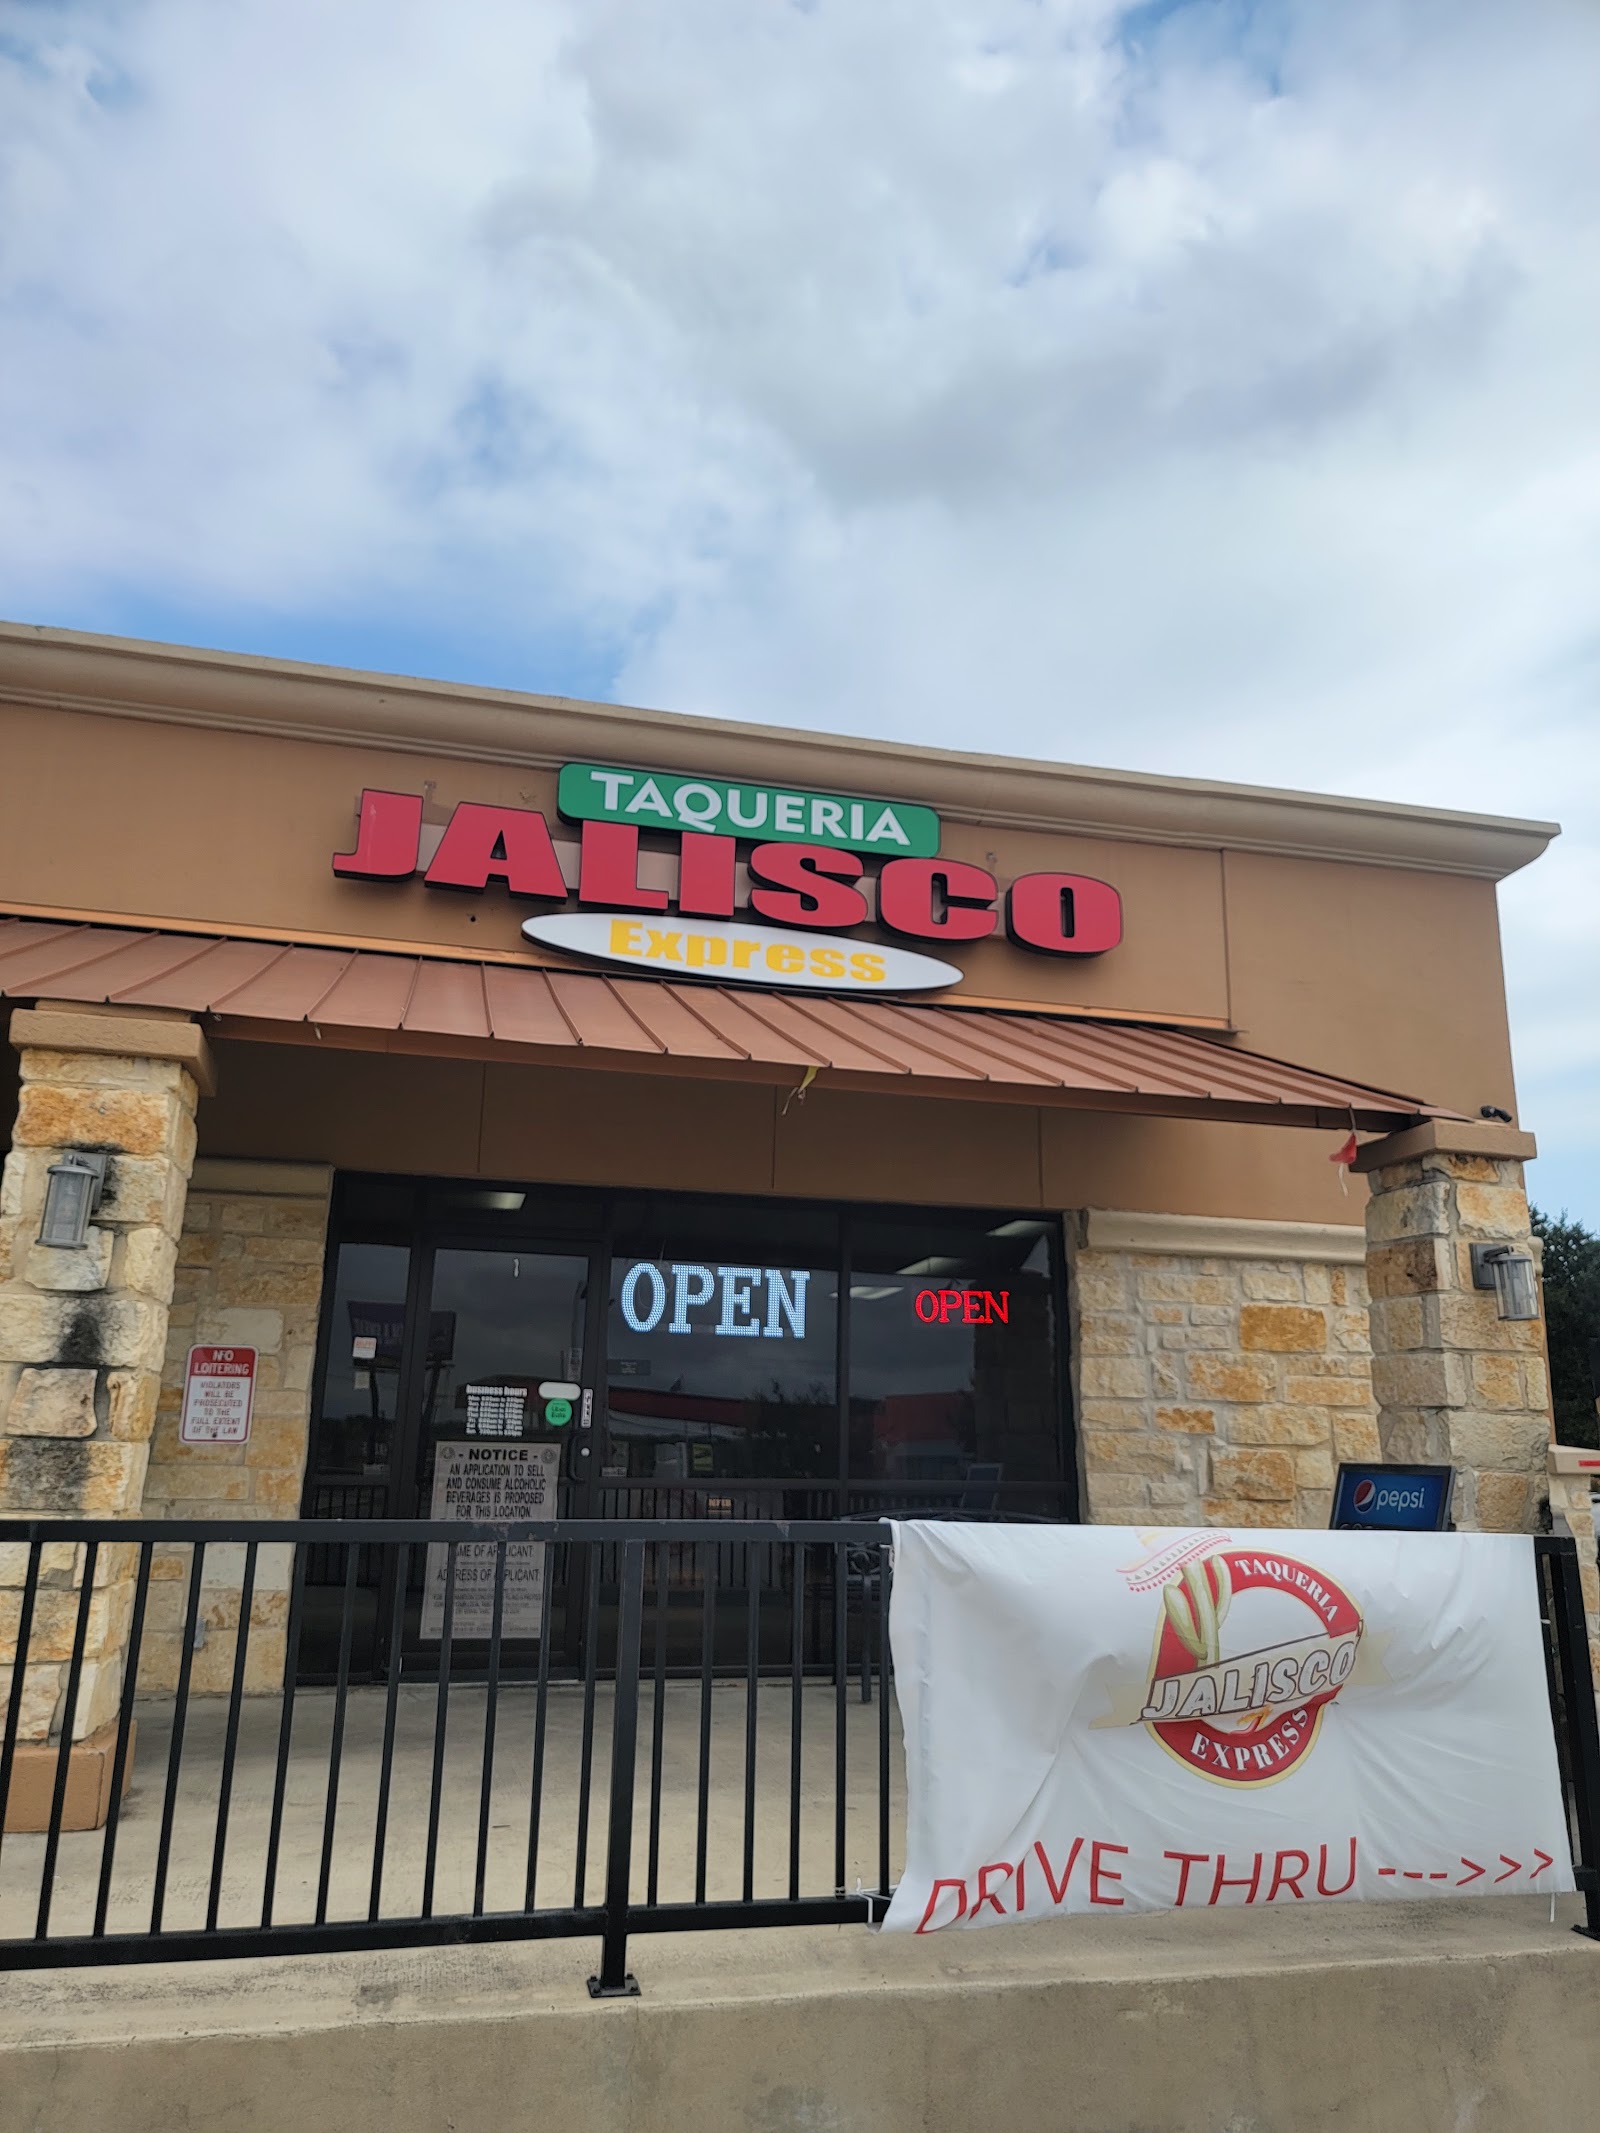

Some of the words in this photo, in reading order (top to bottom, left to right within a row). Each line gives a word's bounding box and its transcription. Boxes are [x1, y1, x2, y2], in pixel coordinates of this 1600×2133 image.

[590, 770, 911, 847] TAQUERIA
[332, 788, 1124, 957] JALISCO
[609, 919, 887, 984] Express
[620, 1262, 811, 1339] OPEN
[914, 1288, 1011, 1325] OPEN
[212, 1349, 234, 1361] NO
[193, 1363, 250, 1375] LOITERING
[200, 1381, 241, 1389] VIOLATORS
[466, 1384, 503, 1396] business
[504, 1386, 528, 1397] hours
[204, 1390, 222, 1398] WILL
[193, 1399, 243, 1407] PROSECUTED
[213, 1417, 241, 1425] EXTENT
[468, 1448, 529, 1461] NOTICE
[450, 1463, 460, 1475] AN
[463, 1464, 511, 1476] APPLICATION
[514, 1464, 524, 1476] TO
[527, 1464, 545, 1477] SELL
[446, 1477, 462, 1489] AND
[465, 1477, 501, 1490] CONSUME
[504, 1478, 546, 1491] ALCOHOLIC
[446, 1490, 491, 1503] BEVERAGES
[494, 1491, 501, 1503] IS
[504, 1491, 545, 1504] PROPOSED
[1376, 1487, 1425, 1512] pepsi
[456, 1505, 472, 1517] FOR
[475, 1505, 491, 1517] THIS
[474, 1545, 486, 1557] OF
[437, 1568, 478, 1581] ADRESS
[480, 1569, 492, 1581] OF
[1235, 1558, 1338, 1622] TAQUERIA
[1141, 1640, 1358, 1721] JALISCO
[1190, 1707, 1309, 1771] EXPRESS
[914, 1836, 1129, 1934] DRIVE
[1163, 1836, 1357, 1906] THRU
